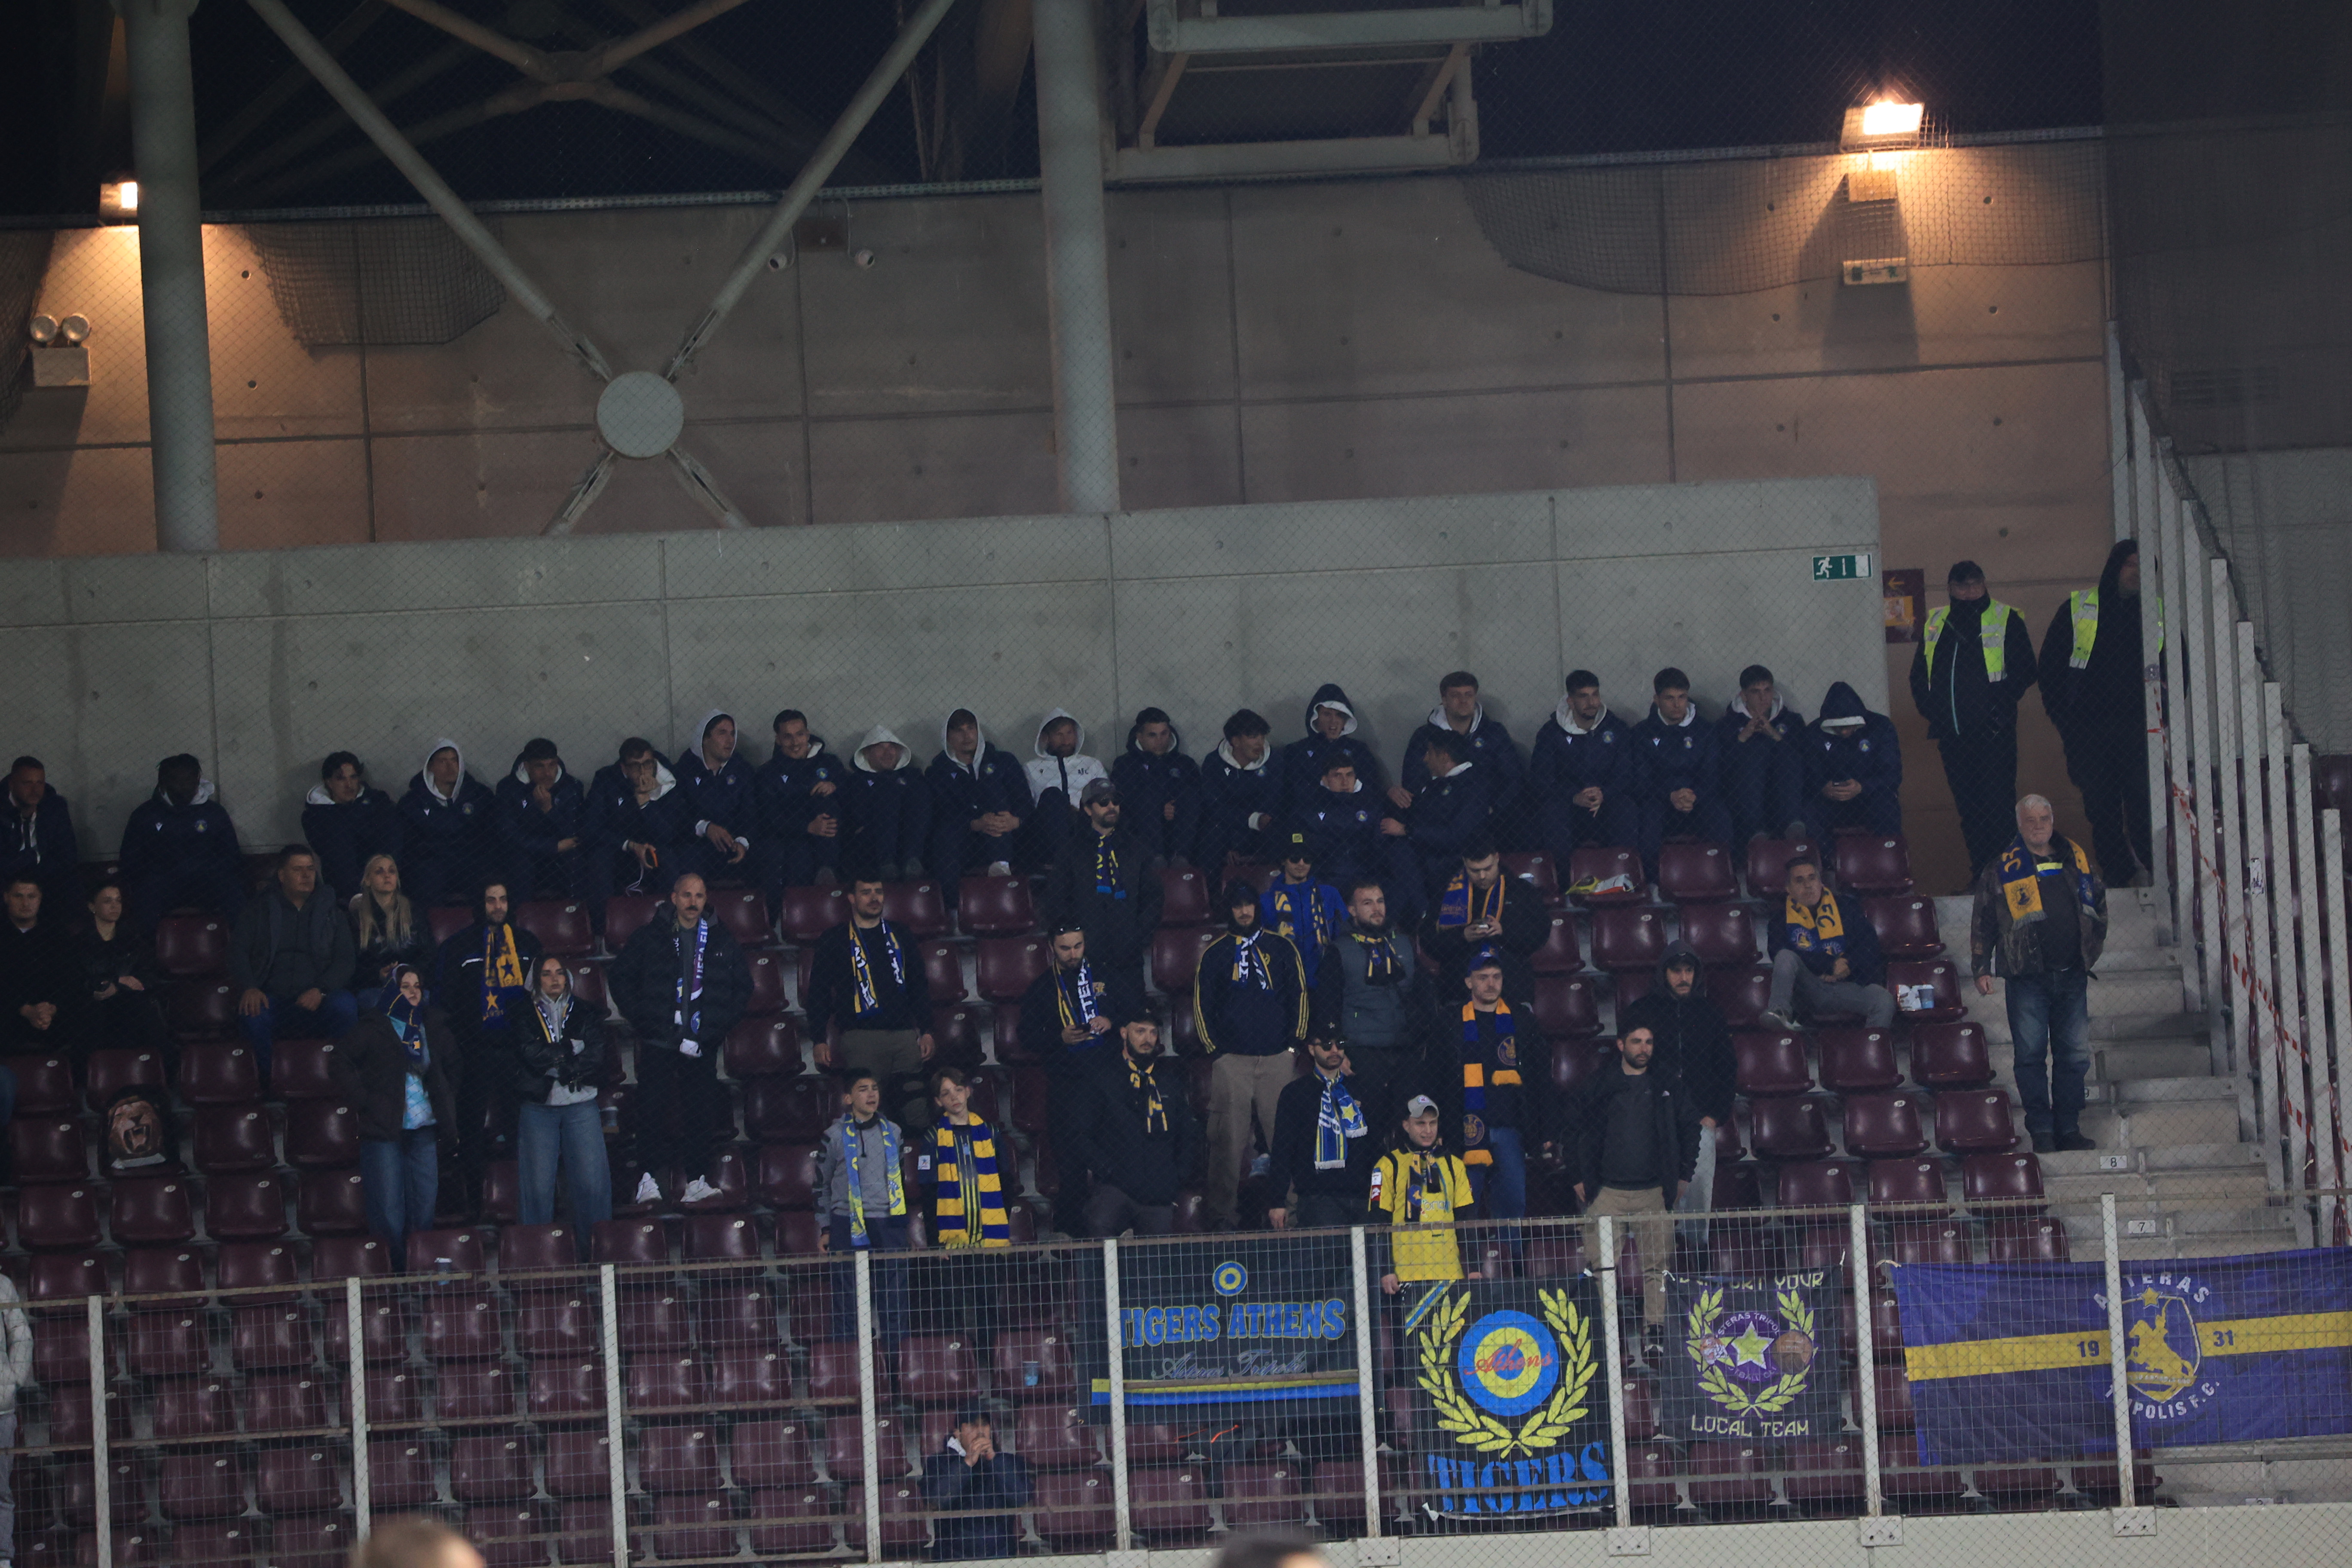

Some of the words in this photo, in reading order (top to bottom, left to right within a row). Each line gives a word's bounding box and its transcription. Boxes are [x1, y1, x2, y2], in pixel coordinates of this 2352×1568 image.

[2110, 1157, 2117, 1167] 8
[2139, 1222, 2145, 1232] 7
[1775, 1271, 1824, 1290] YOUR
[2093, 1271, 2209, 1310] ATERAS
[1120, 1304, 1221, 1349] TIGERS
[1228, 1298, 1346, 1340] ATHENS
[1715, 1312, 1751, 1338] STERAS
[1464, 1338, 1554, 1375] Athens
[2076, 1341, 2099, 1358] 19
[2213, 1329, 2235, 1348] 31
[2105, 1384, 2187, 1420] TPOLIS
[1691, 1415, 1752, 1437] LOCAL
[1761, 1420, 1809, 1437] TEAM
[1427, 1440, 1609, 1514] TIGERS
